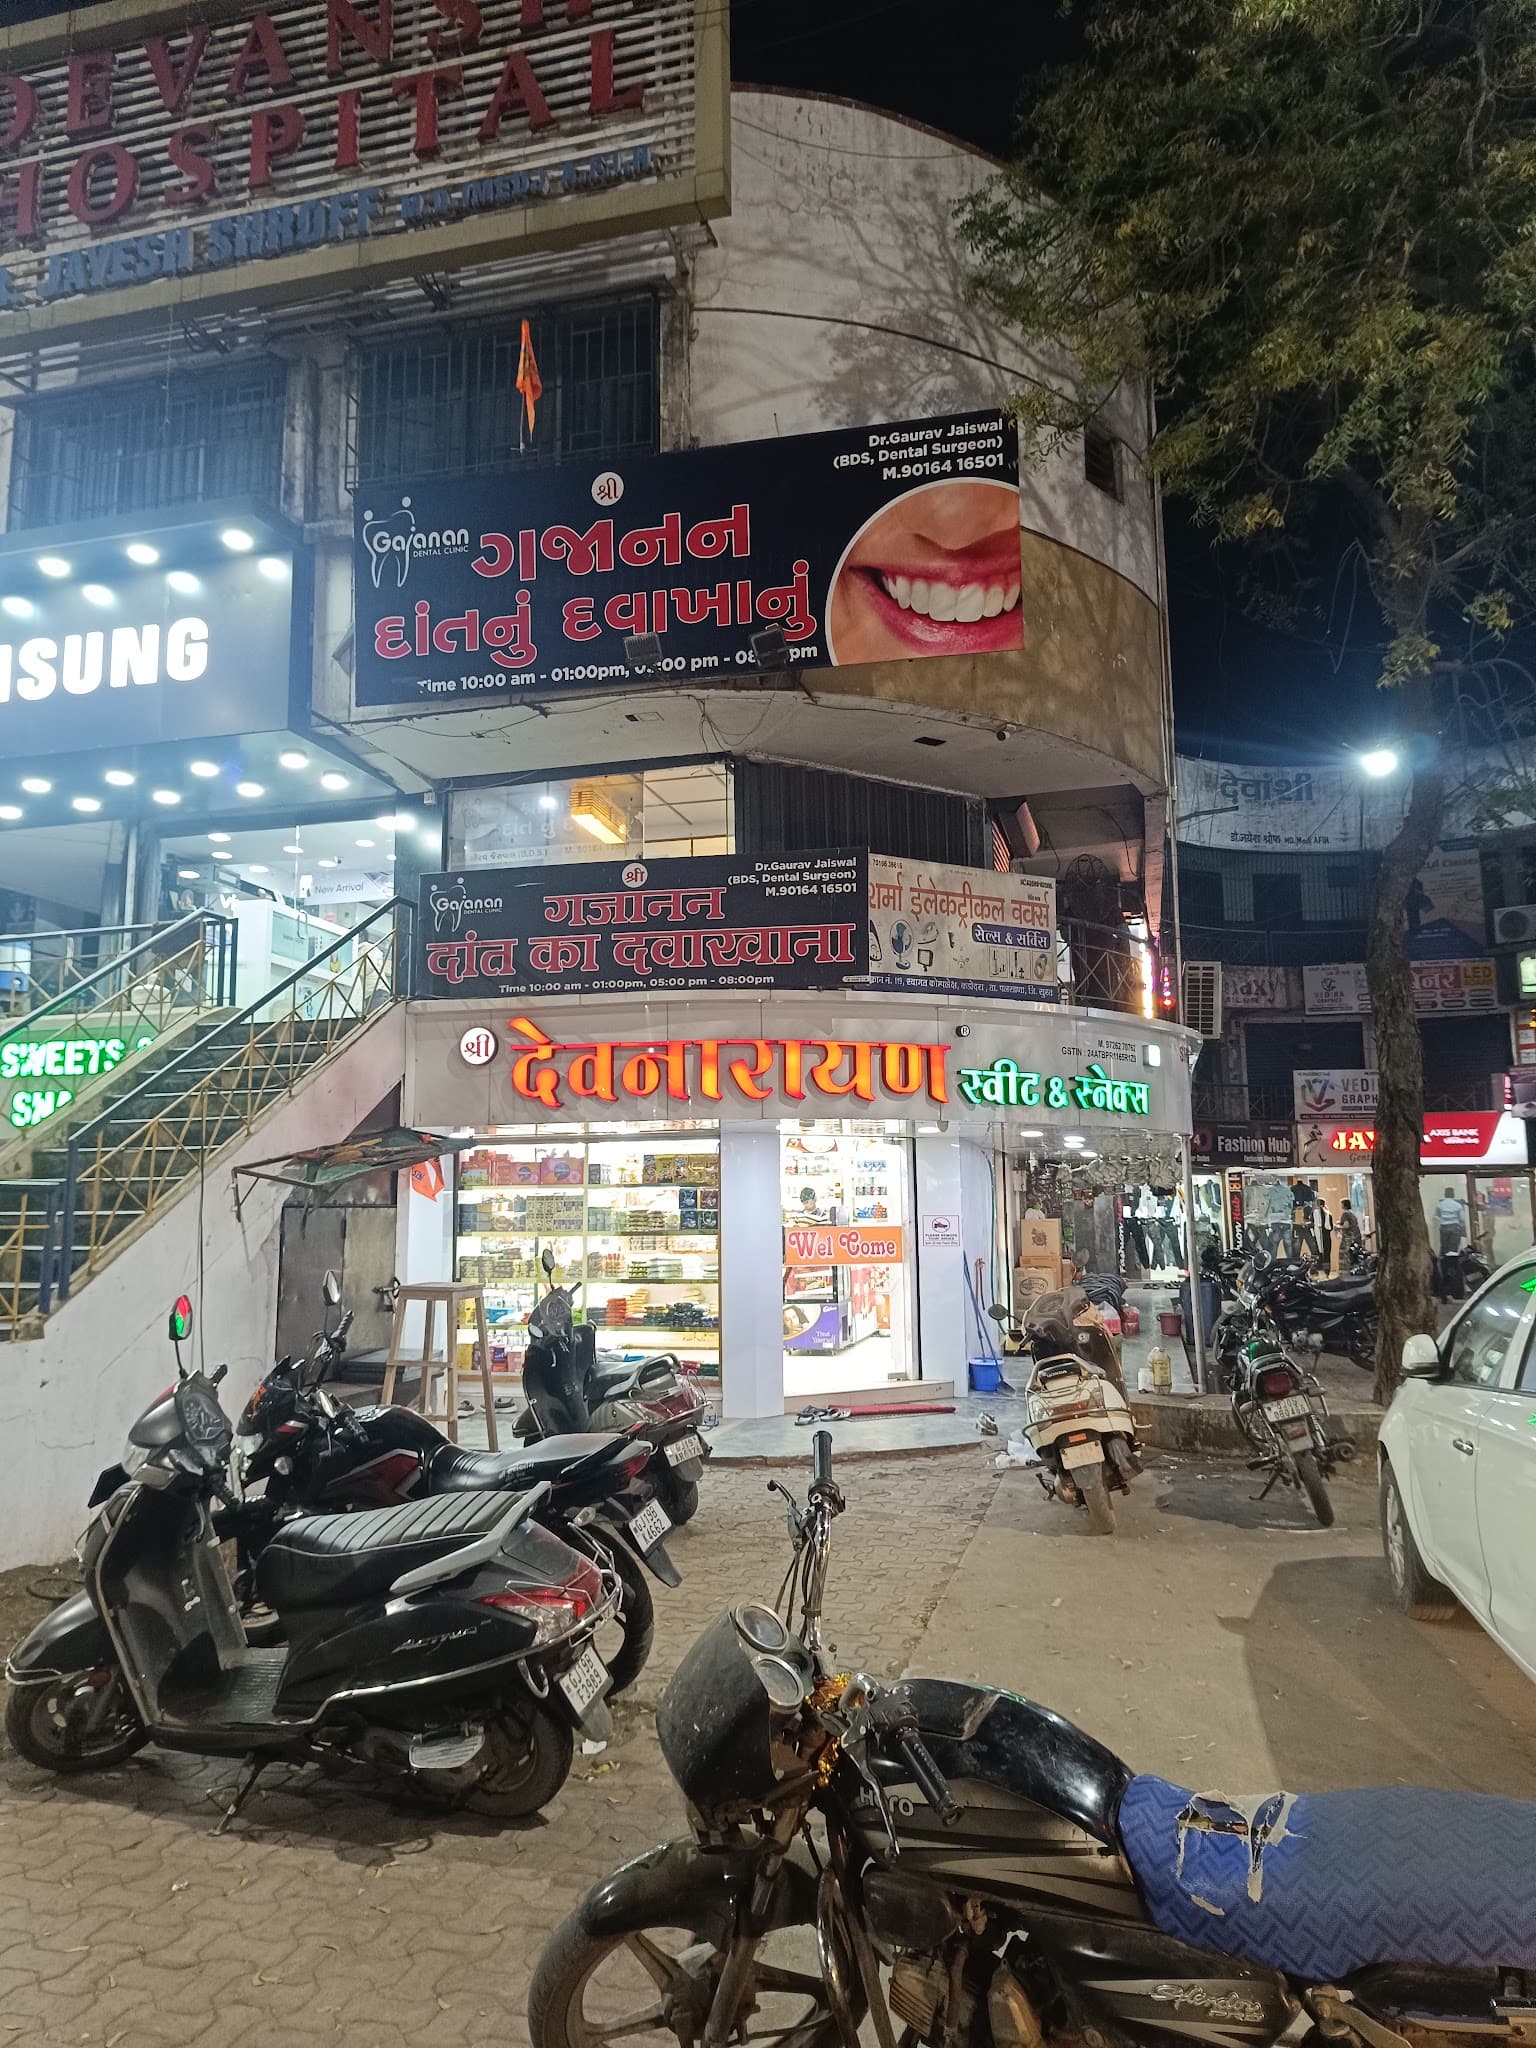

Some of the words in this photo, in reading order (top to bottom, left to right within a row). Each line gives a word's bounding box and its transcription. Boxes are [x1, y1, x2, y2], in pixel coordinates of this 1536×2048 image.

[37, 227, 194, 299] JAYESH
[207, 187, 386, 264] SHROFF
[868, 427, 943, 448] Dr.Gaurav
[947, 418, 1003, 437] Jaiswal
[833, 452, 875, 469] (BDS,
[878, 444, 928, 463] Dental
[931, 435, 1003, 455] Surgeon)
[882, 460, 952, 481] M.90164
[956, 453, 1004, 471] 16501
[372, 526, 469, 553] Gajanan
[413, 549, 442, 558] DENTAL
[444, 544, 469, 555] CLINIC
[471, 503, 750, 581] ગજાનન
[562, 559, 818, 642] દવાખાનું
[373, 588, 537, 667] દાંતનું
[0, 617, 210, 700] SUNG
[460, 673, 507, 691] 10:00
[510, 673, 536, 687] am
[551, 664, 630, 683] 01:00pm,
[689, 655, 720, 671] pm
[727, 875, 760, 886] (BDS,
[762, 872, 800, 883] Dental
[802, 869, 857, 881] Surgeon)
[755, 861, 811, 872] Dr.Gaurav
[814, 856, 857, 868] Jaiswal
[315, 884, 335, 894] New
[336, 881, 365, 893] Arrival
[765, 886, 818, 897] M.90164
[822, 883, 857, 893] 16501
[868, 872, 904, 913] शर्मा
[436, 895, 503, 912] Gajanan
[543, 887, 727, 926] गजानन
[974, 927, 1001, 943] सेल्स
[1005, 933, 1012, 945] &
[1016, 931, 1048, 948] सर्विस
[426, 930, 519, 984] दांत
[527, 934, 602, 974] का
[611, 923, 856, 976] दवाखाना
[499, 984, 526, 994] Time
[529, 983, 561, 993] 10:00
[563, 983, 582, 991] am
[592, 979, 647, 990] 01:00pm,
[649, 977, 685, 987] 05:00
[688, 979, 708, 988] pm
[718, 975, 774, 985] 08:00pm
[1463, 966, 1492, 979] LED
[0, 1038, 126, 1079] SWEETS
[465, 1032, 490, 1058] श्री
[1061, 1046, 1082, 1057] GSTIN
[507, 1017, 951, 1109] देवनारायण
[958, 1058, 1040, 1106] स्वीट
[1048, 1076, 1069, 1109] &
[1072, 1064, 1149, 1114] स्नेक्स
[1217, 1135, 1265, 1153] Fashion
[1267, 1136, 1290, 1153] Hub
[1429, 1128, 1451, 1136] AXIS
[1452, 1128, 1479, 1136] BANK
[789, 1231, 833, 1257] Wel
[839, 1231, 896, 1256] Come
[634, 1505, 658, 1532] GJ19B
[568, 1653, 594, 1689] GJ19B
[577, 1668, 602, 1706] F3989
